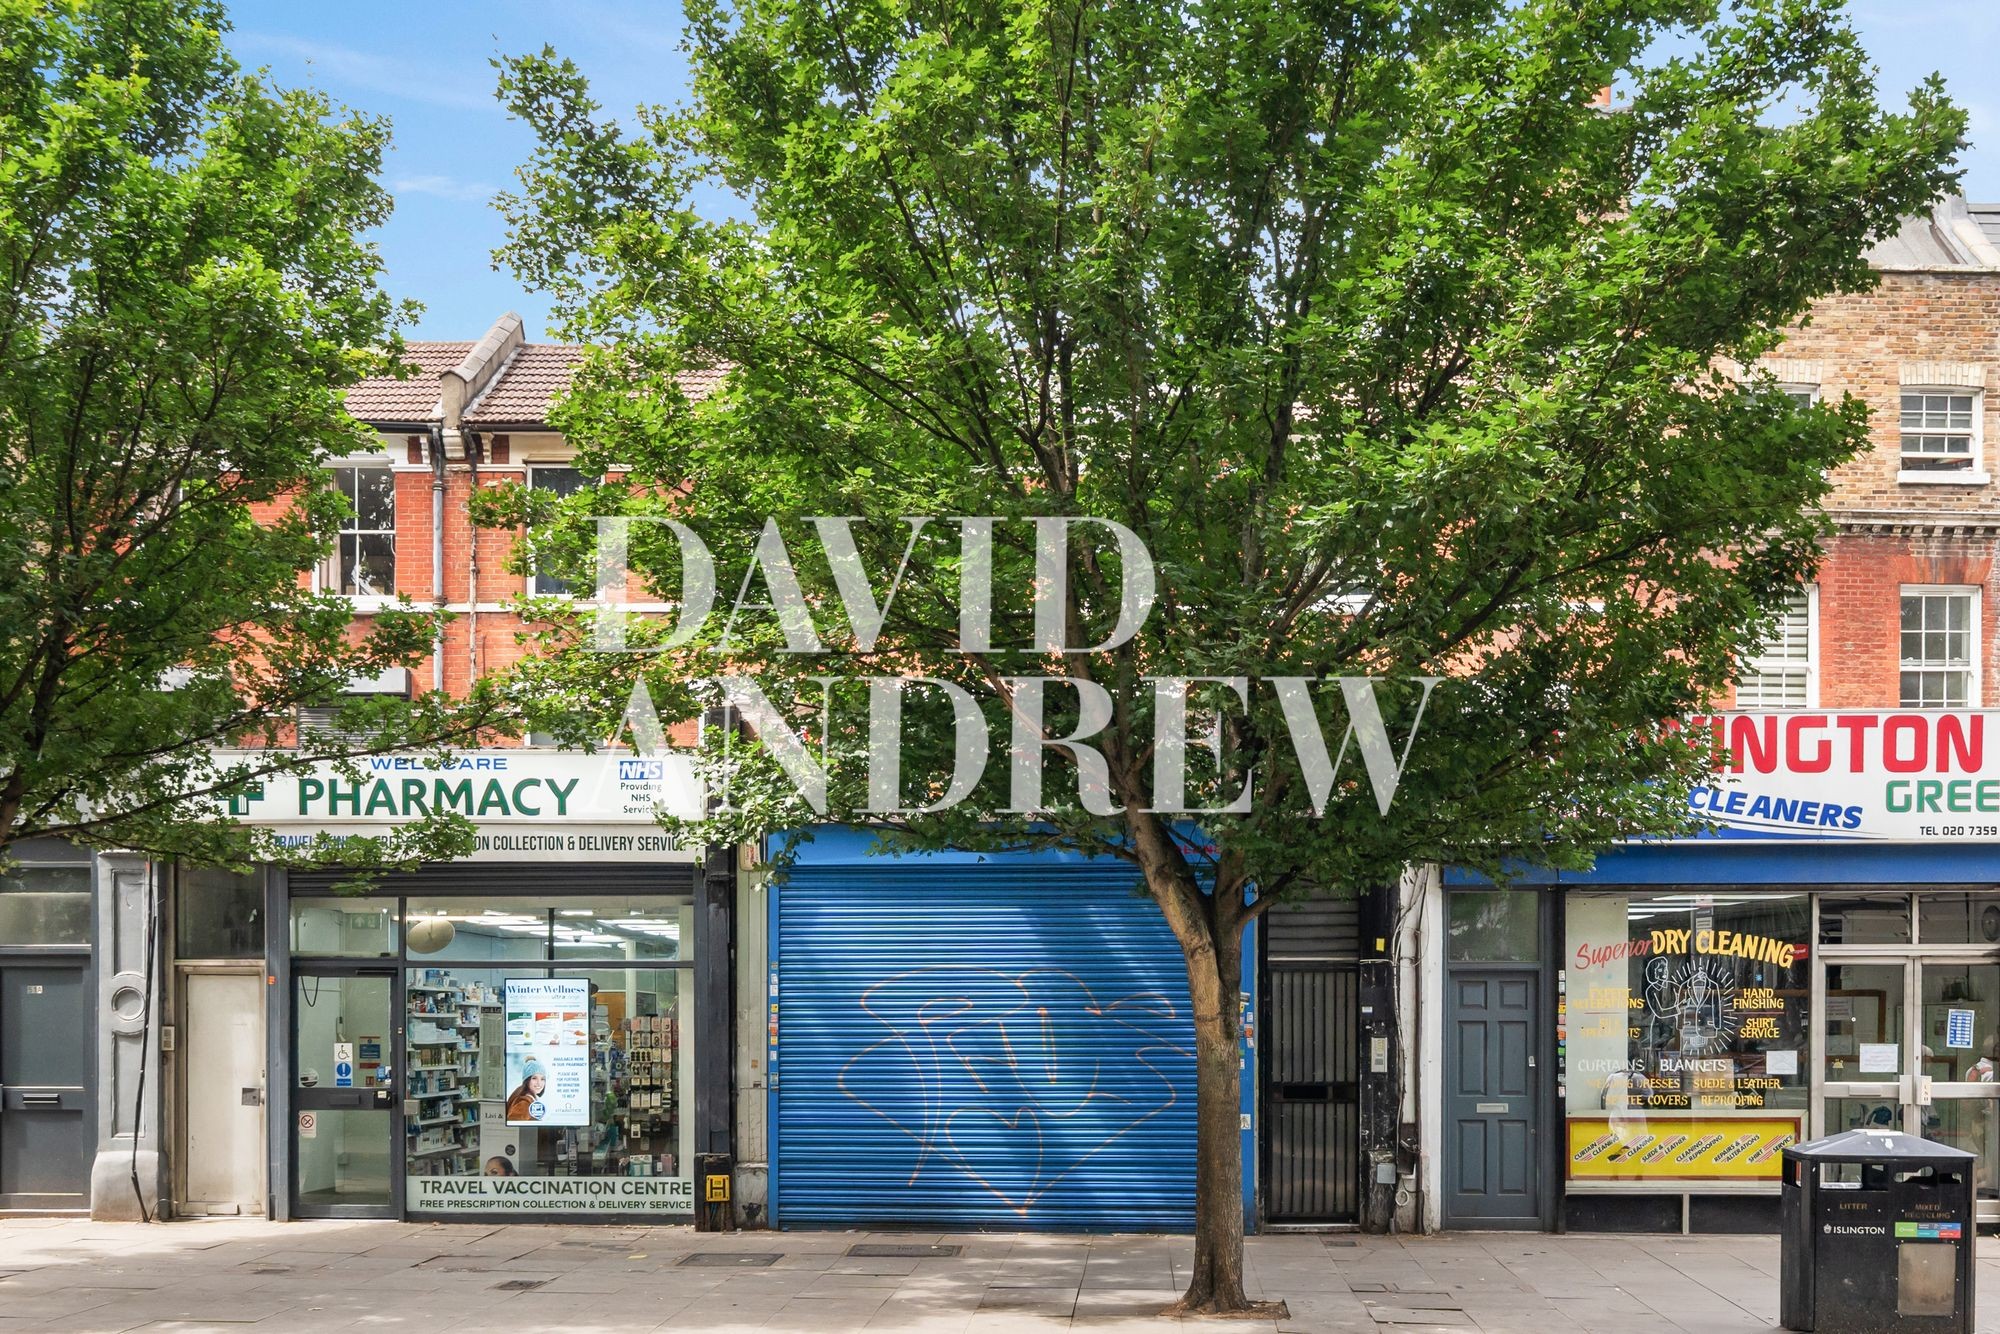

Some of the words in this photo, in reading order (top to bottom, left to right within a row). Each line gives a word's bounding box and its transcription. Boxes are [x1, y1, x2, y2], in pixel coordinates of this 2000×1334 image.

[1659, 714, 1984, 774] INGTON
[371, 758, 507, 770] WELCARE
[620, 761, 662, 779] NHS
[621, 782, 662, 792] Providing
[299, 778, 579, 816] PHARMACY
[631, 794, 651, 802] NHS
[1886, 780, 2000, 813] GREE
[1687, 786, 1863, 829] CLEANERS
[1920, 826, 1939, 836] TEL
[1942, 826, 1964, 836] 020
[1968, 826, 1997, 836] 7359
[493, 836, 564, 851] COLLECTION
[567, 836, 575, 851] &
[579, 836, 634, 851] DELIVERY
[637, 836, 685, 851] SERVIC
[1575, 938, 1655, 969] Superior
[1650, 928, 1691, 955] DRY
[1696, 930, 1794, 968] CLEANING
[507, 985, 541, 994] Winter
[543, 984, 586, 994] Wellness
[1743, 988, 1774, 999] HAND
[1733, 998, 1784, 1009] FINISHING
[1746, 1018, 1776, 1028] SHIRT
[1740, 1027, 1780, 1038] SERVICE
[1660, 1059, 1727, 1073] BLANKETS
[1693, 1078, 1725, 1089] SUEDE
[1737, 1078, 1783, 1089] LEATHER
[1647, 1094, 1688, 1106] COVERS
[1701, 1095, 1763, 1106] REPROOFING
[1574, 1142, 1598, 1160] CURTAIN
[1627, 1135, 1654, 1157] CLEANING
[1664, 1136, 1687, 1155] LEATHER
[1676, 1140, 1703, 1162] CLEANING
[1689, 1134, 1723, 1161] REPROOFING
[1726, 1134, 1760, 1162] ALTERATIONS
[1773, 1135, 1793, 1153] SERVICE
[1642, 1148, 1658, 1162] SUEDE
[1714, 1144, 1736, 1162] REPAIRS
[1748, 1149, 1764, 1162] SHIRT
[420, 1181, 487, 1194] TRAVEL
[492, 1181, 616, 1195] VACCINATION
[621, 1181, 692, 1195] CENTRE
[710, 1178, 726, 1199] H
[420, 1200, 444, 1208] FREE
[447, 1200, 520, 1208] PRESCRIPTION
[523, 1200, 586, 1209] COLLECTION
[589, 1200, 595, 1209] &
[599, 1200, 646, 1209] DELIVERY
[649, 1200, 692, 1209] SERVICE
[1833, 1226, 1885, 1235] ISLINGTON
